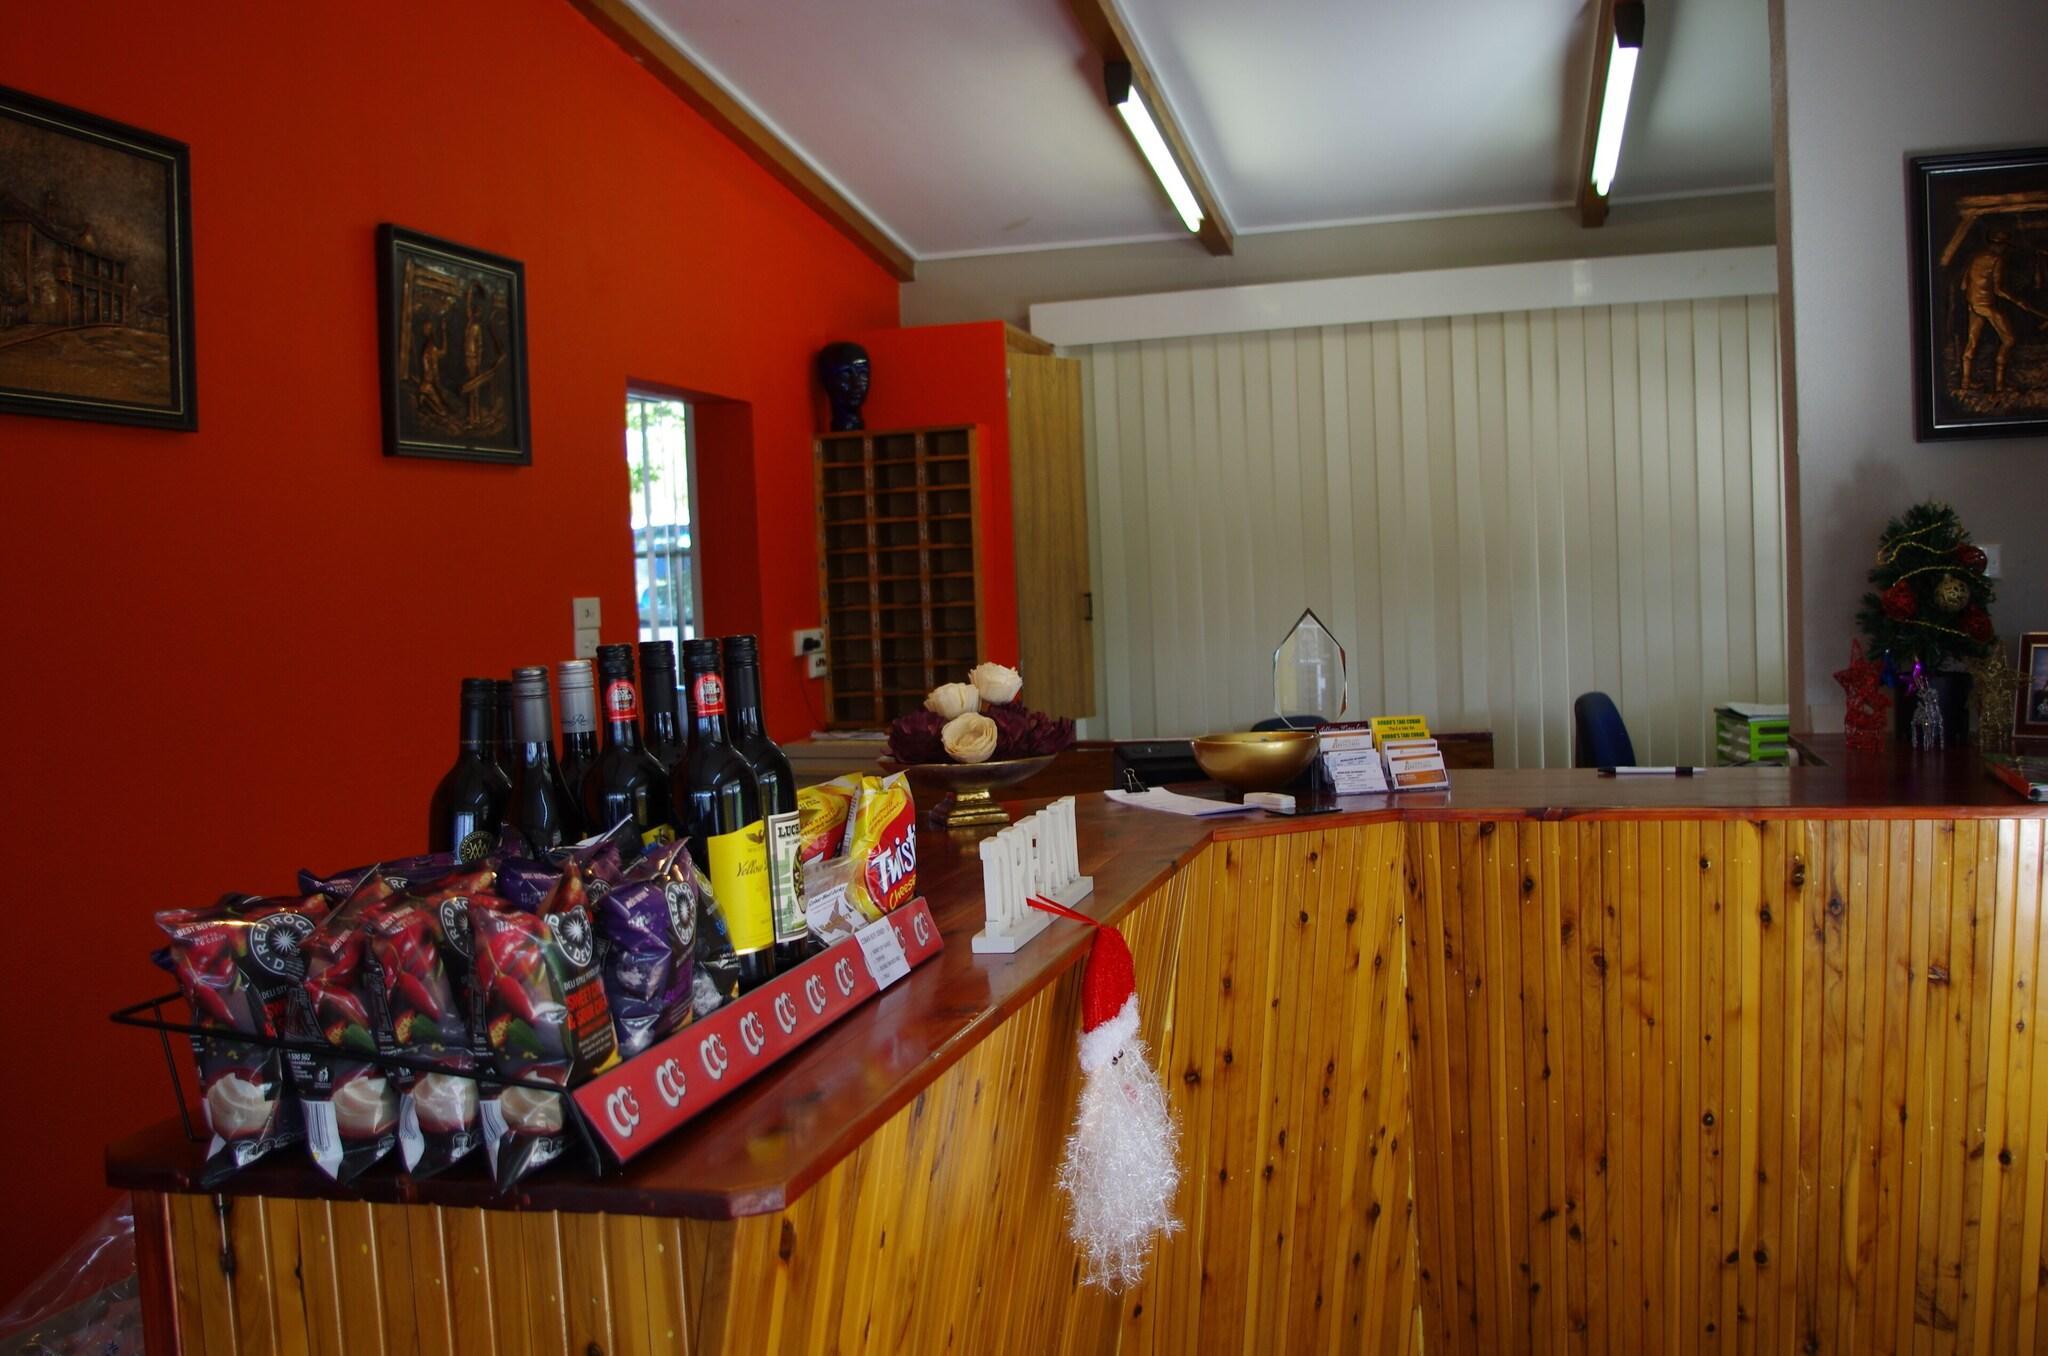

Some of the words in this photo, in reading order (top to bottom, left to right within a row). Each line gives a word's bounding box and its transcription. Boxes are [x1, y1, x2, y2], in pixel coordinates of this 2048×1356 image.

[736, 859, 765, 878] Yellow
[254, 923, 271, 956] RED
[443, 907, 461, 940] RED
